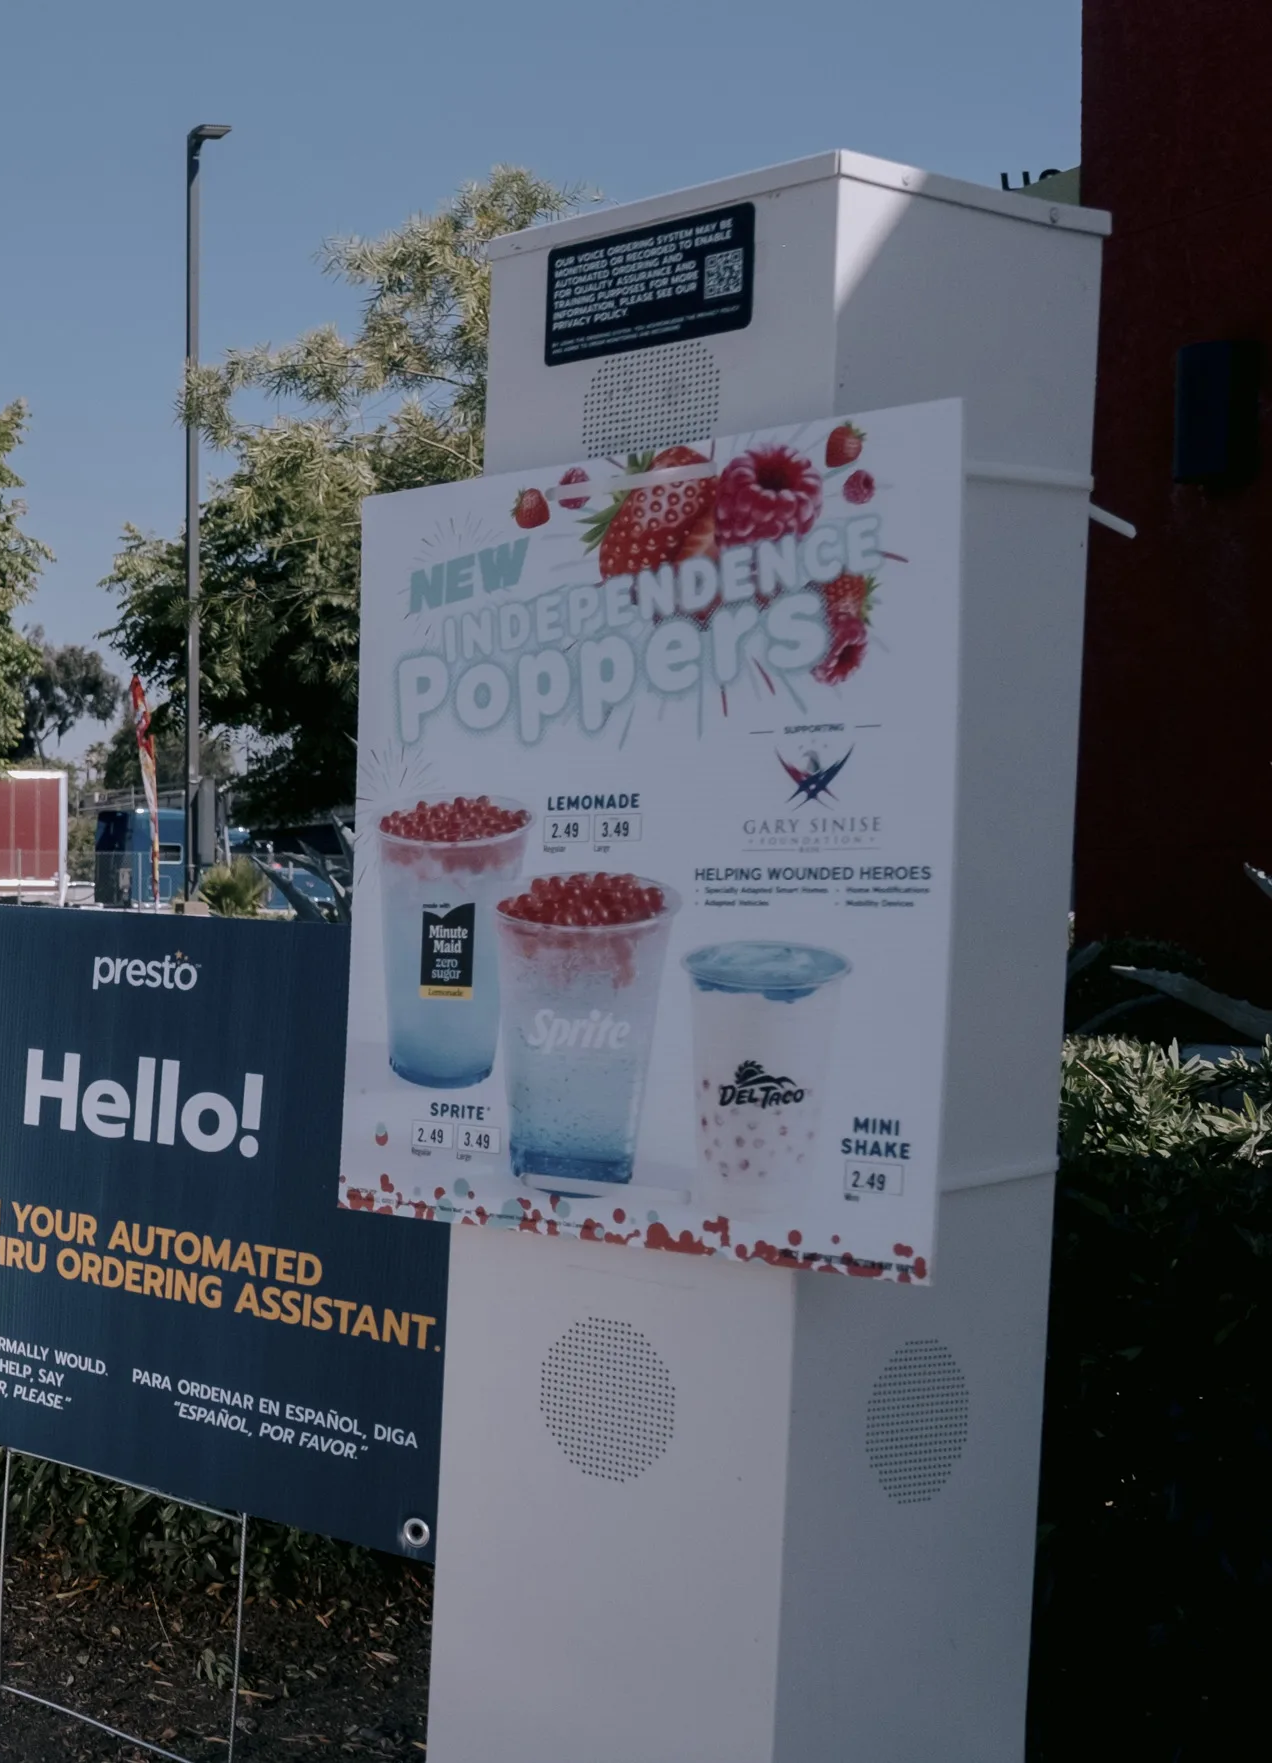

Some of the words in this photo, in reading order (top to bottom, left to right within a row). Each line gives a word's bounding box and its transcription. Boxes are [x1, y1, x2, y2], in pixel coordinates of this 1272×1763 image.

[555, 257, 575, 269] OUR
[579, 250, 604, 265] VOICE
[607, 239, 654, 257] ORDERING
[657, 229, 694, 246] SYSTEM
[696, 223, 717, 236] MAY
[720, 219, 733, 230] BE
[555, 260, 607, 279] MONITORED
[610, 256, 623, 267] OR
[626, 244, 676, 263] RECORDED
[679, 240, 691, 251] TO
[695, 230, 732, 247] ENABLE
[554, 271, 609, 289] AUTOMATED
[612, 260, 659, 277] ORDERING
[662, 254, 683, 265] AND
[554, 287, 571, 300] FOR
[574, 279, 613, 297] QUALITY
[616, 266, 672, 286] ASSURANCE
[674, 262, 696, 273] AND
[554, 295, 594, 311] TRAINING
[649, 278, 668, 291] FOR
[671, 271, 699, 286] MORE
[620, 293, 653, 307] PLEASE
[657, 288, 673, 301] SEE
[675, 283, 697, 296] OUR
[553, 315, 591, 332] PRIVACY
[408, 536, 530, 615] NEW
[441, 516, 883, 662] INDEPENDENCE
[396, 592, 829, 743] Poppers
[784, 723, 845, 734] SUPPORTING
[547, 793, 640, 811] LEMONADE
[551, 822, 579, 839] 2.49
[601, 821, 629, 838] 3.49
[743, 819, 800, 835] GARY
[810, 816, 882, 833] SINISE
[760, 836, 862, 845] FOUNDATION
[695, 868, 762, 881] HELPING
[767, 867, 854, 881] WOUNDED
[859, 866, 932, 880] HEROES
[428, 924, 468, 940] Minute
[433, 940, 462, 954] Maid
[92, 953, 197, 990] presto
[432, 968, 461, 982] sugar
[436, 958, 458, 969] zero
[428, 988, 463, 997] Lemonade
[528, 1009, 630, 1054] Sprite
[23, 1048, 264, 1158] Hello!
[417, 1127, 444, 1144] 2.49
[464, 1132, 490, 1149] 3.49
[853, 1117, 900, 1136] MINI
[840, 1138, 911, 1160] SHAKE
[851, 1170, 887, 1191] 2.49
[11, 1202, 98, 1246] YOUR
[107, 1220, 323, 1287] AUTOMATED
[56, 1247, 222, 1308] ORDERING
[234, 1282, 442, 1353] ASSISTANT.
[0, 1359, 33, 1383] HELP,
[38, 1368, 64, 1387] SAY
[54, 1350, 109, 1376] WOULD.
[132, 1368, 172, 1392] PARA
[178, 1379, 253, 1411] ORDENAR
[259, 1397, 280, 1416] EN
[285, 1404, 368, 1440] ESPAÑOL,
[374, 1423, 418, 1448] DIGA
[259, 1423, 293, 1444] POR
